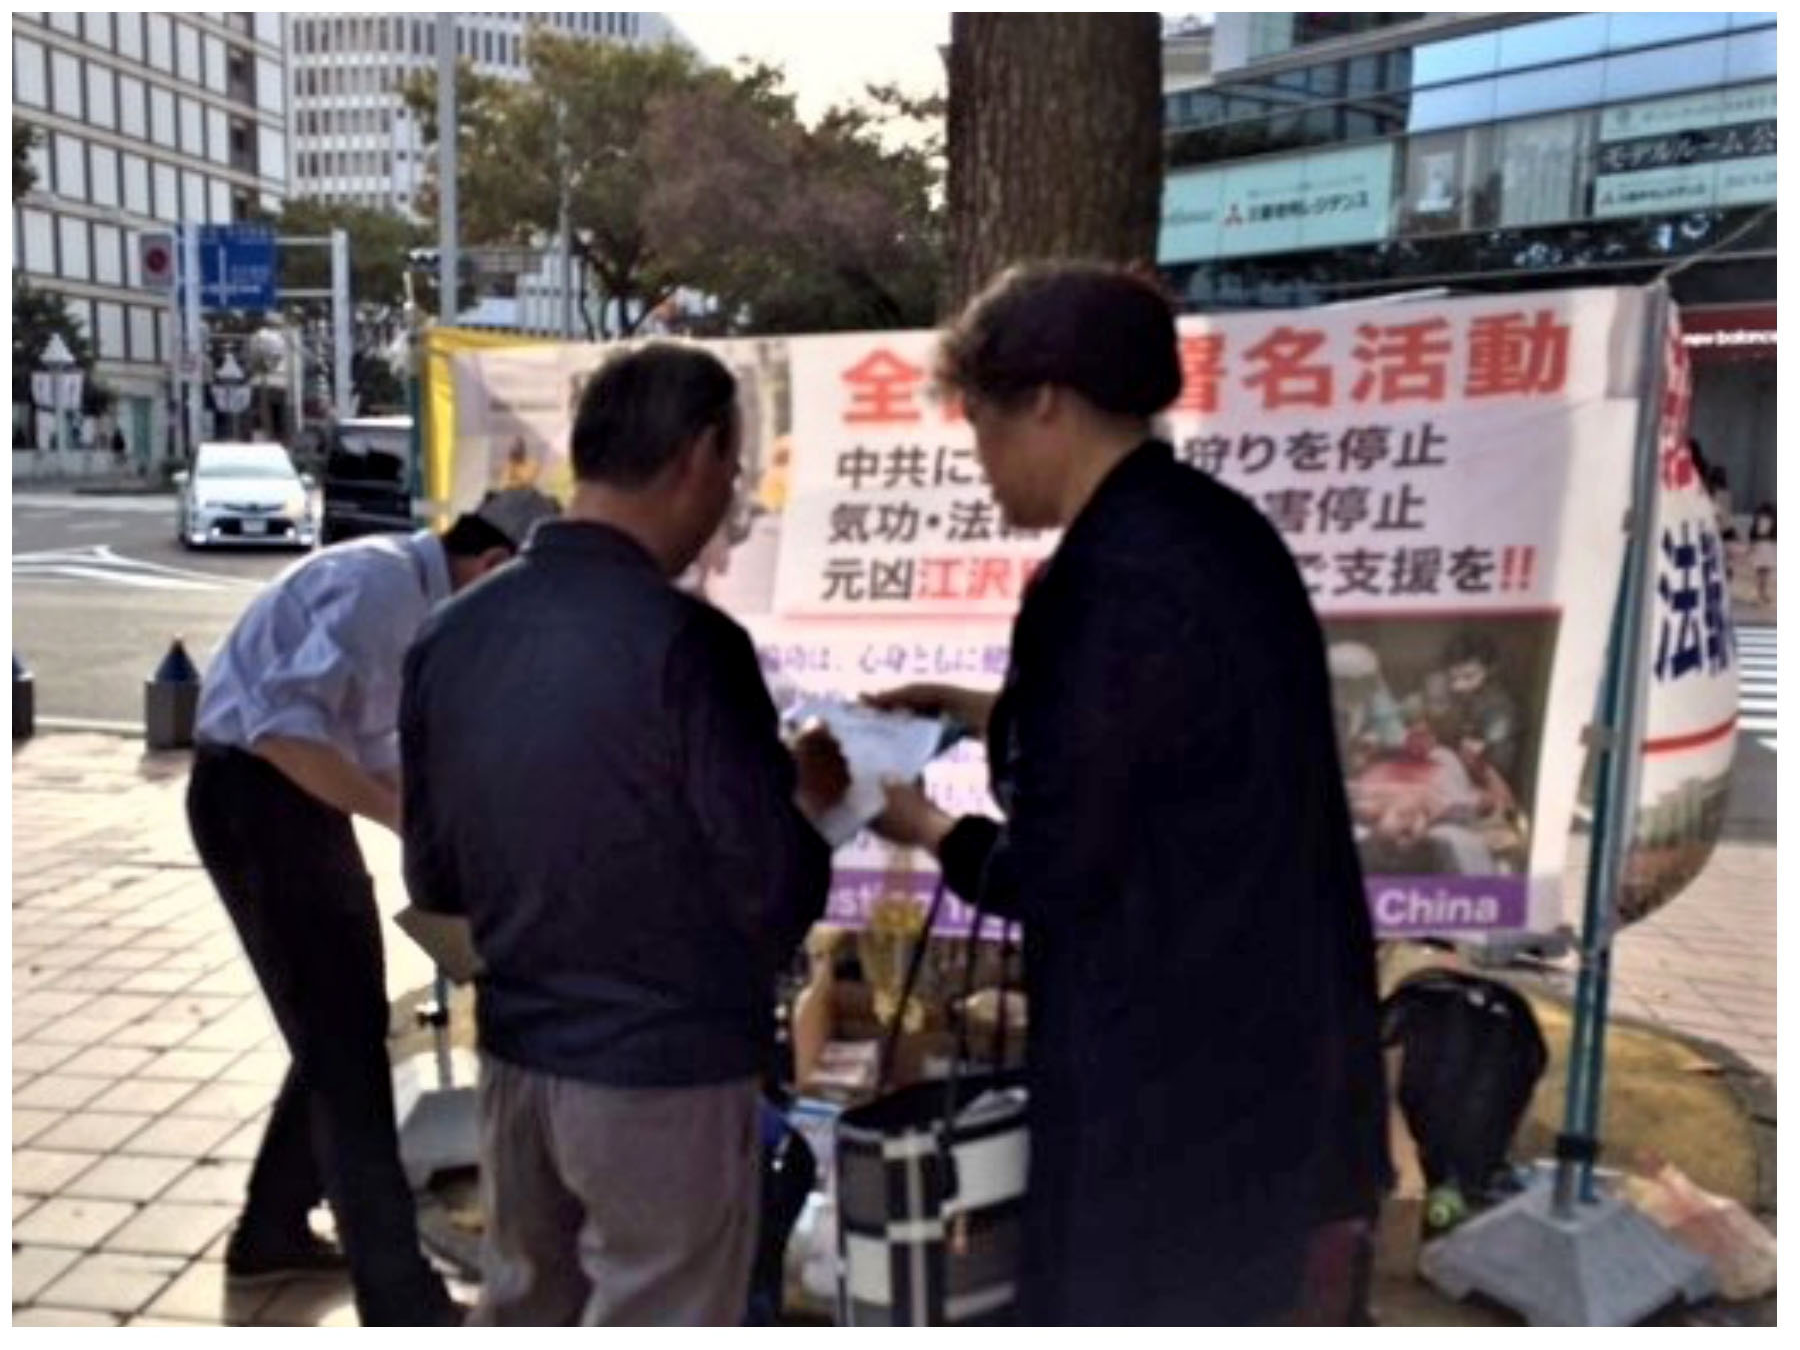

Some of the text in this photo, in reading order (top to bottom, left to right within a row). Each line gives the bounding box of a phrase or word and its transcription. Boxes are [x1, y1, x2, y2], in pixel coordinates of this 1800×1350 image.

[836, 444, 990, 490] 中共に
[829, 482, 1426, 542] 気功・法 害停止
[1376, 887, 1498, 926] China
